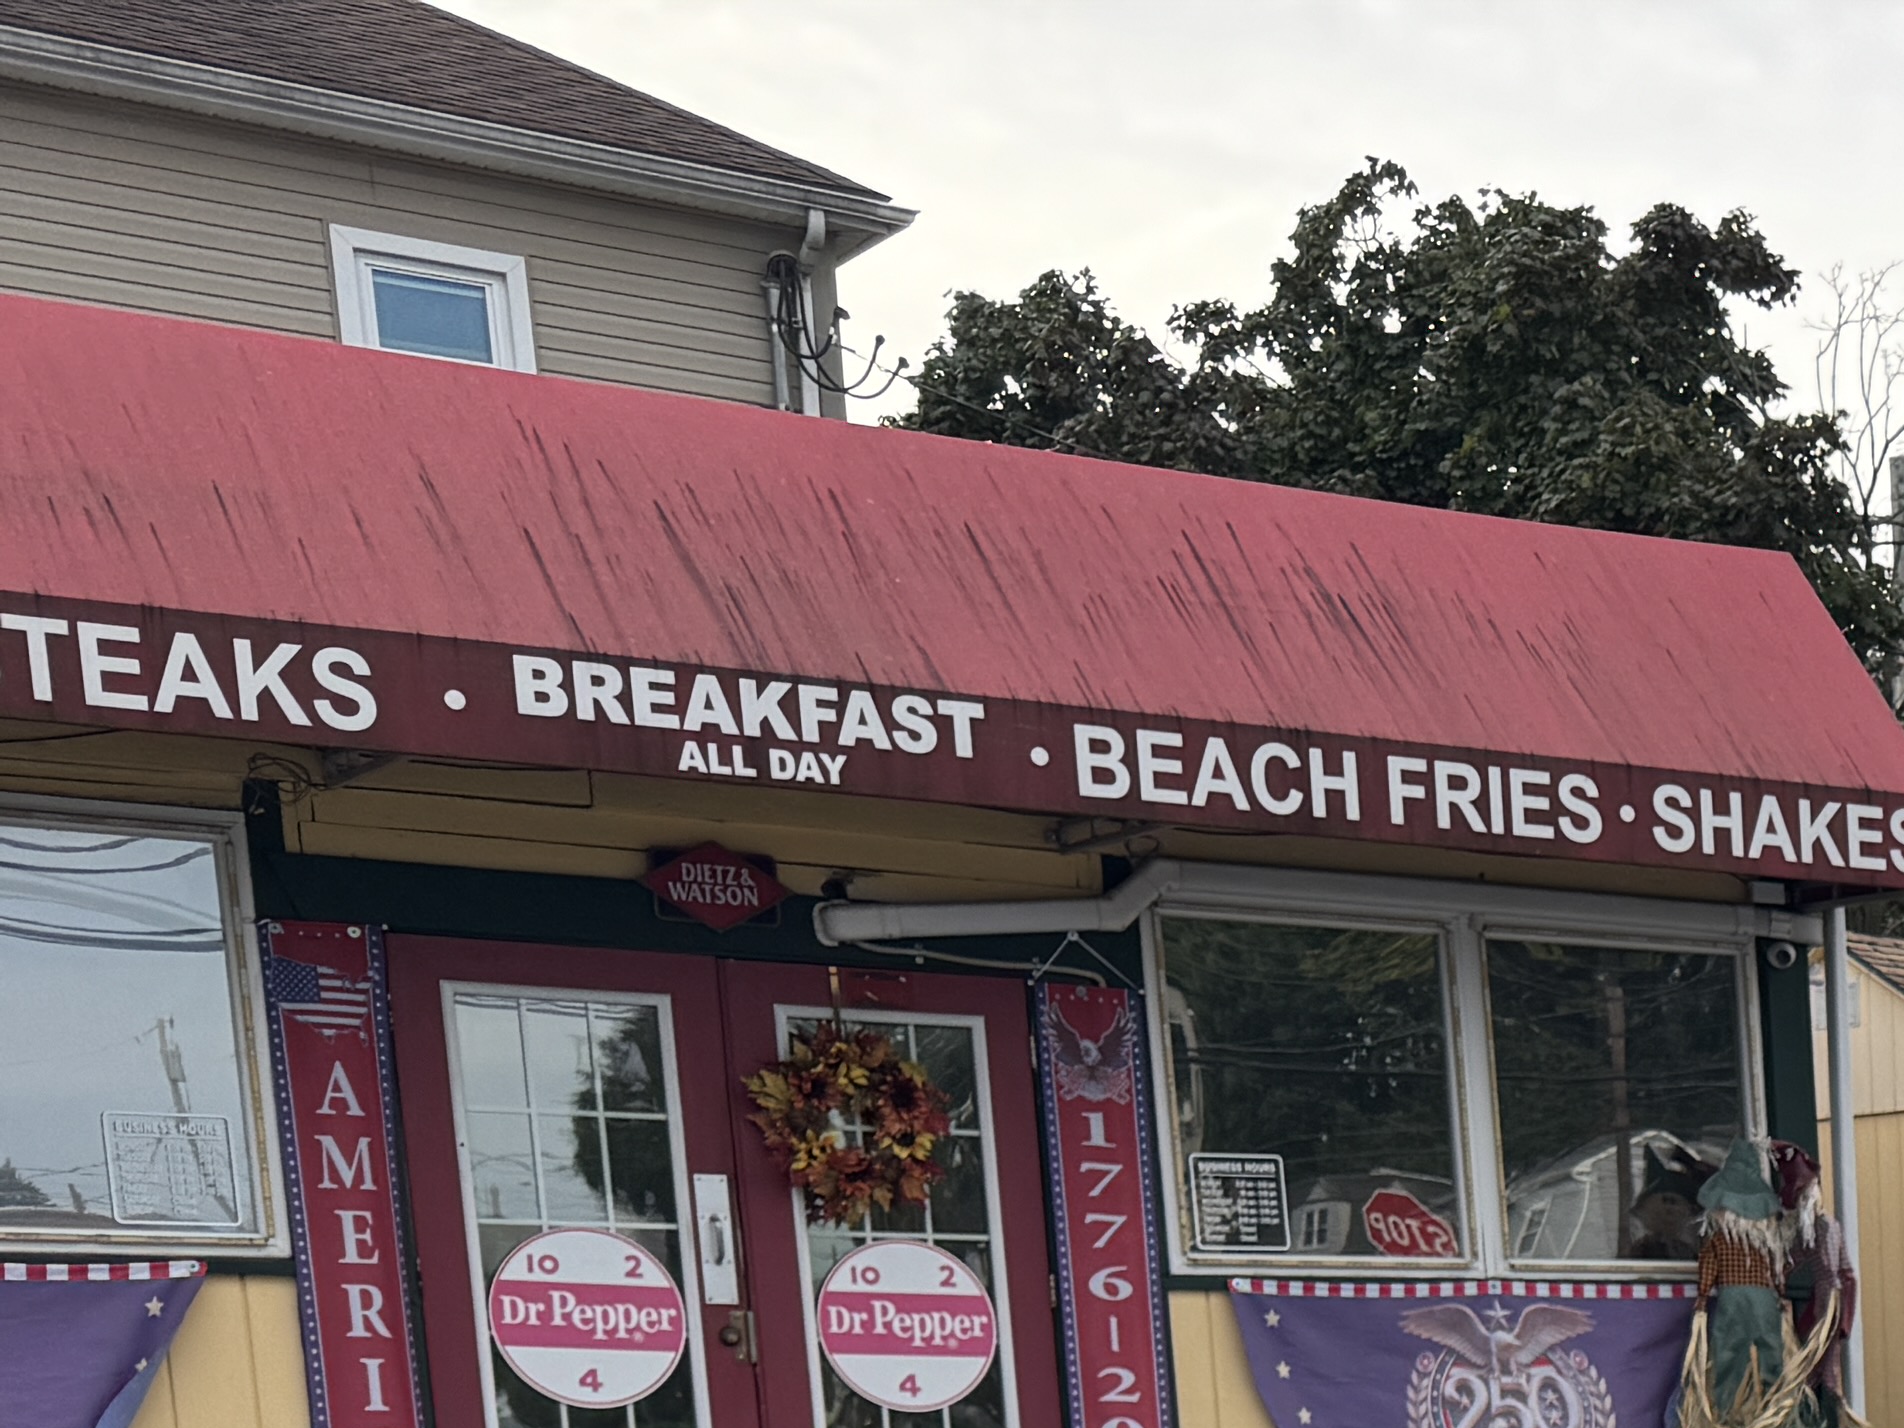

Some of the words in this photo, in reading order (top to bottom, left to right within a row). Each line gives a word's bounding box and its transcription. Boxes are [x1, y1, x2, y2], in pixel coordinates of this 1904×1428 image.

[0, 613, 379, 732] TEAKS
[512, 653, 986, 759] BREAKFAST
[678, 740, 757, 779] ALL
[769, 748, 848, 786] DAY
[1073, 723, 1360, 823] BEACH
[1387, 754, 1604, 845] FRIES
[681, 862, 737, 885] DIETZ
[740, 868, 756, 888] &
[668, 881, 758, 907] WATSON
[527, 1253, 559, 1275] 10
[624, 1255, 643, 1279] 2
[850, 1265, 880, 1286] 10
[939, 1265, 957, 1288] 2
[498, 1295, 545, 1325] Dr
[548, 1290, 677, 1340] Pepper
[826, 1305, 868, 1334] Dr
[870, 1300, 988, 1347] Pepper
[579, 1368, 603, 1393] 4
[899, 1373, 922, 1398] 4
